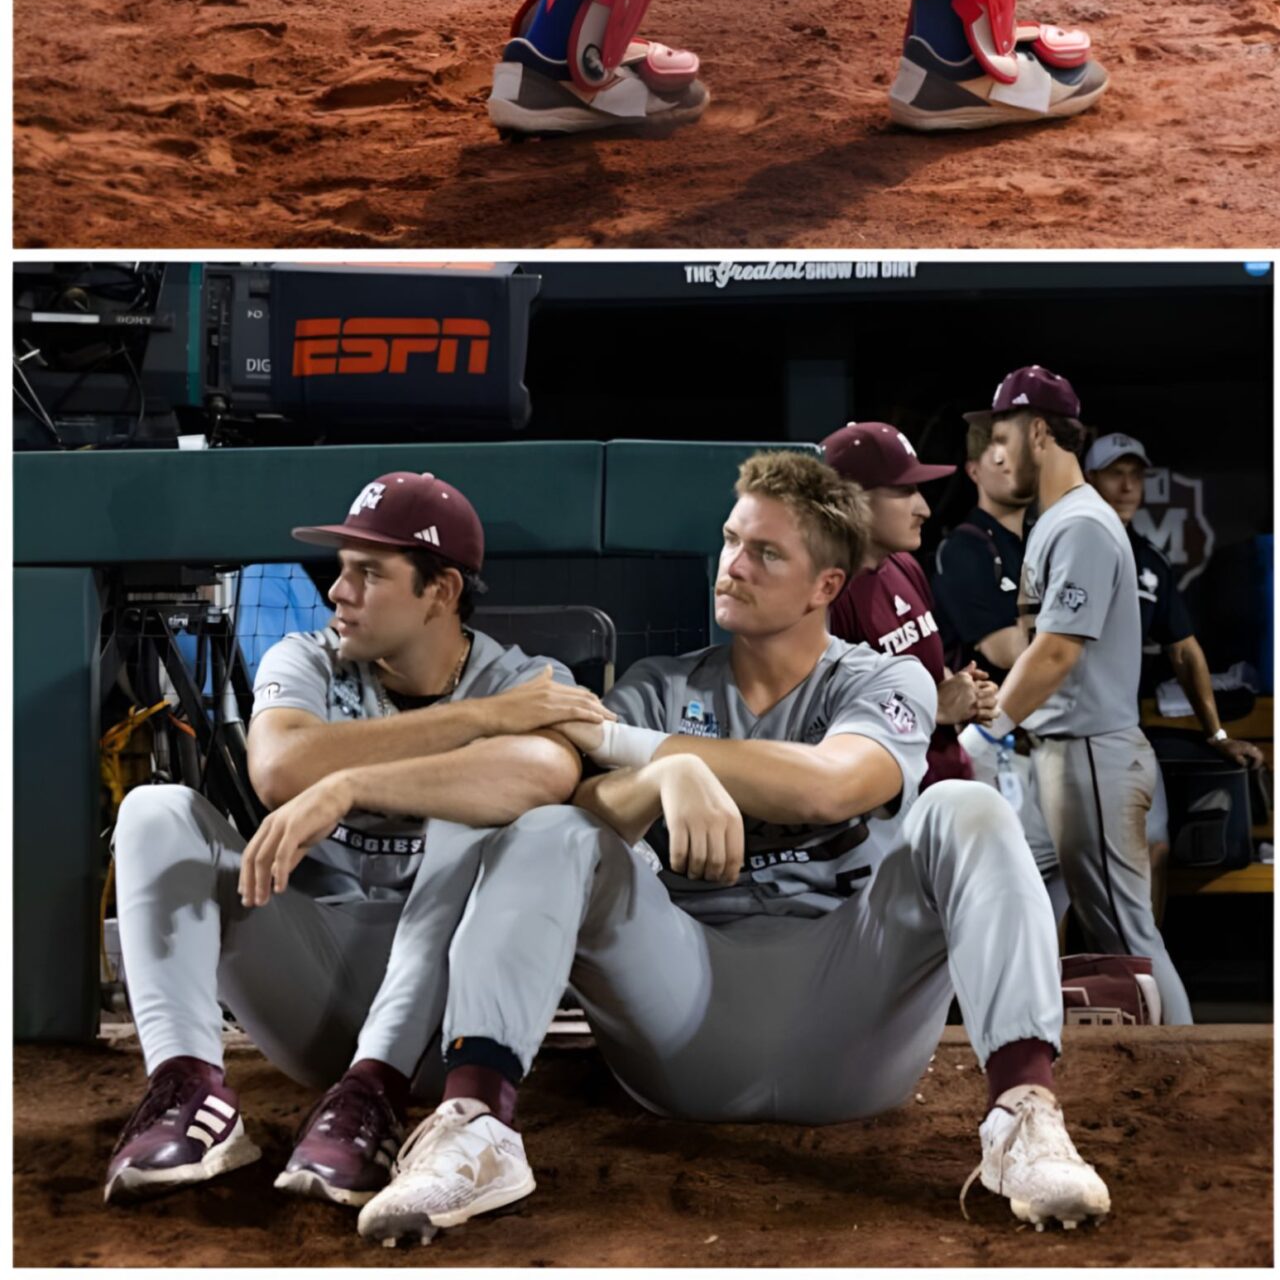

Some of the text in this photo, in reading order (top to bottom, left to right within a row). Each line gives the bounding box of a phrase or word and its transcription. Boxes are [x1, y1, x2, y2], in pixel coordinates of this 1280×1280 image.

[685, 261, 918, 288] THE Greatest SHOW ON DIRT
[292, 317, 491, 377] ESPN
[332, 826, 422, 853] AGGIES
[740, 850, 810, 869] GIES
